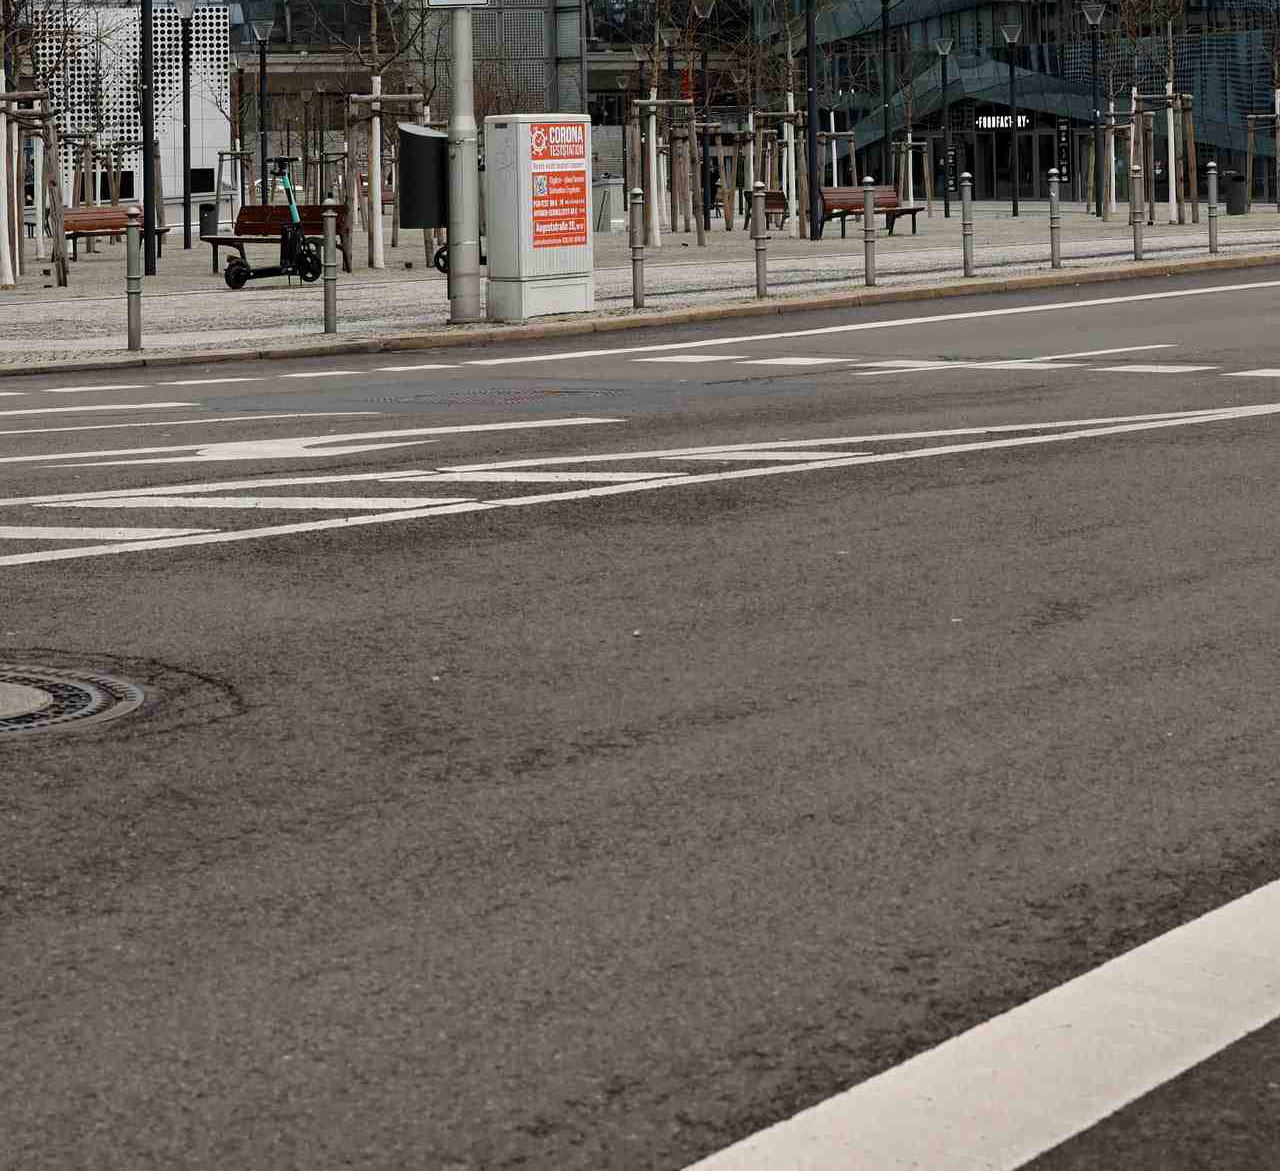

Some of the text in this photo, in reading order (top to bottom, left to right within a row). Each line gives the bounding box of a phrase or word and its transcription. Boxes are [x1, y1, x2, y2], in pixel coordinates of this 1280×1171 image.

[978, 115, 1027, 129] FOODFACTRY
[549, 126, 584, 144] CORONA
[549, 144, 584, 156] TESTSTATION
